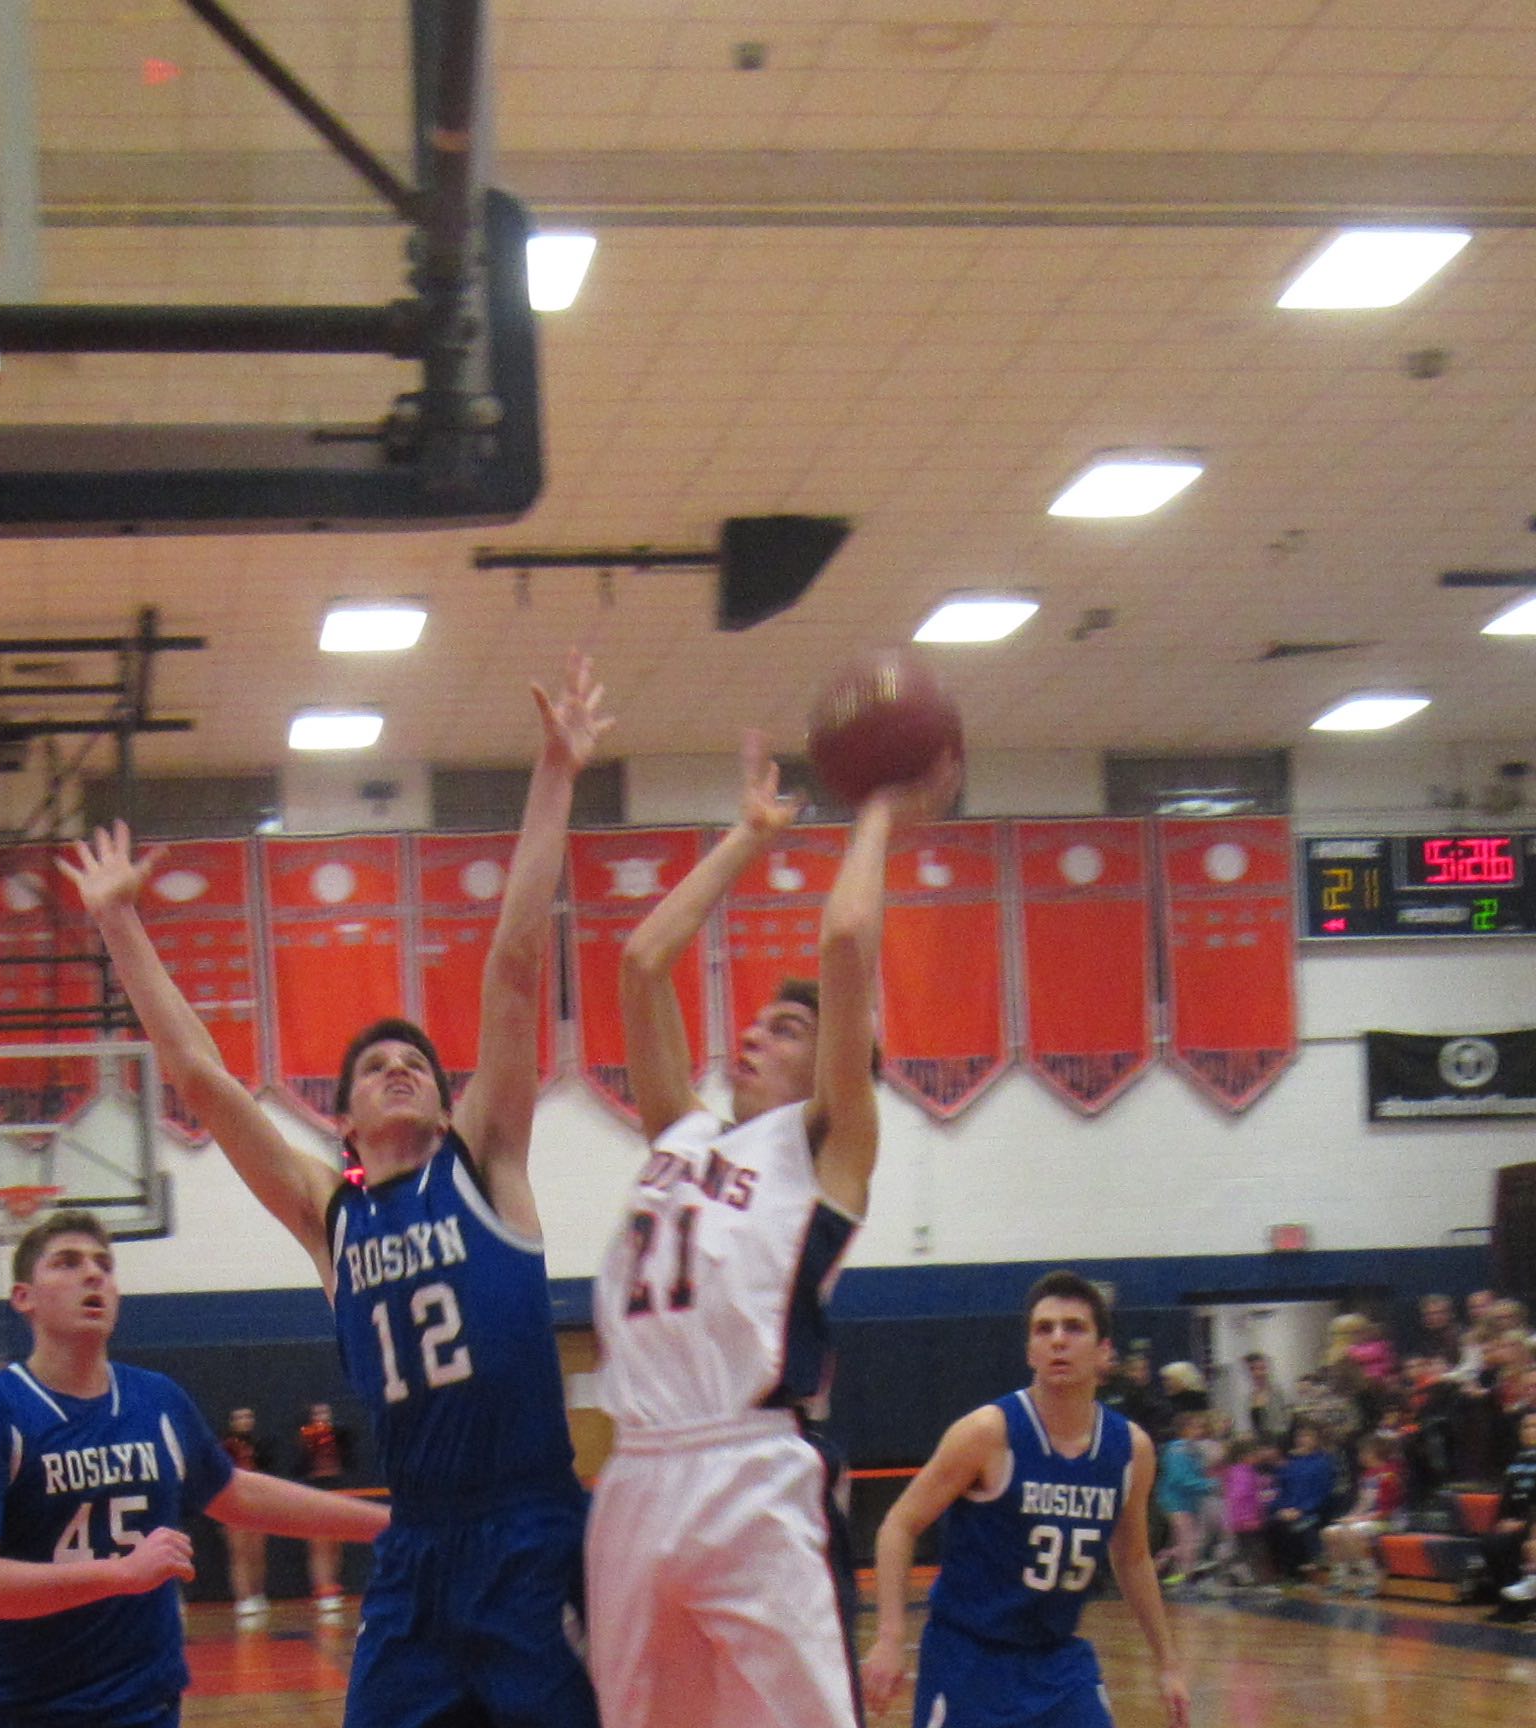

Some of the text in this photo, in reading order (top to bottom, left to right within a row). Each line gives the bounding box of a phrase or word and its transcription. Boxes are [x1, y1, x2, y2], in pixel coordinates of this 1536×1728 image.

[1472, 897, 1499, 931] 2
[345, 1215, 466, 1294] ROSLYN
[371, 1282, 473, 1403] 12
[41, 1442, 158, 1494] ROSLYN
[1020, 1481, 1117, 1521] ROSLYN
[53, 1496, 148, 1564] 45
[1022, 1525, 1101, 1592] 35
